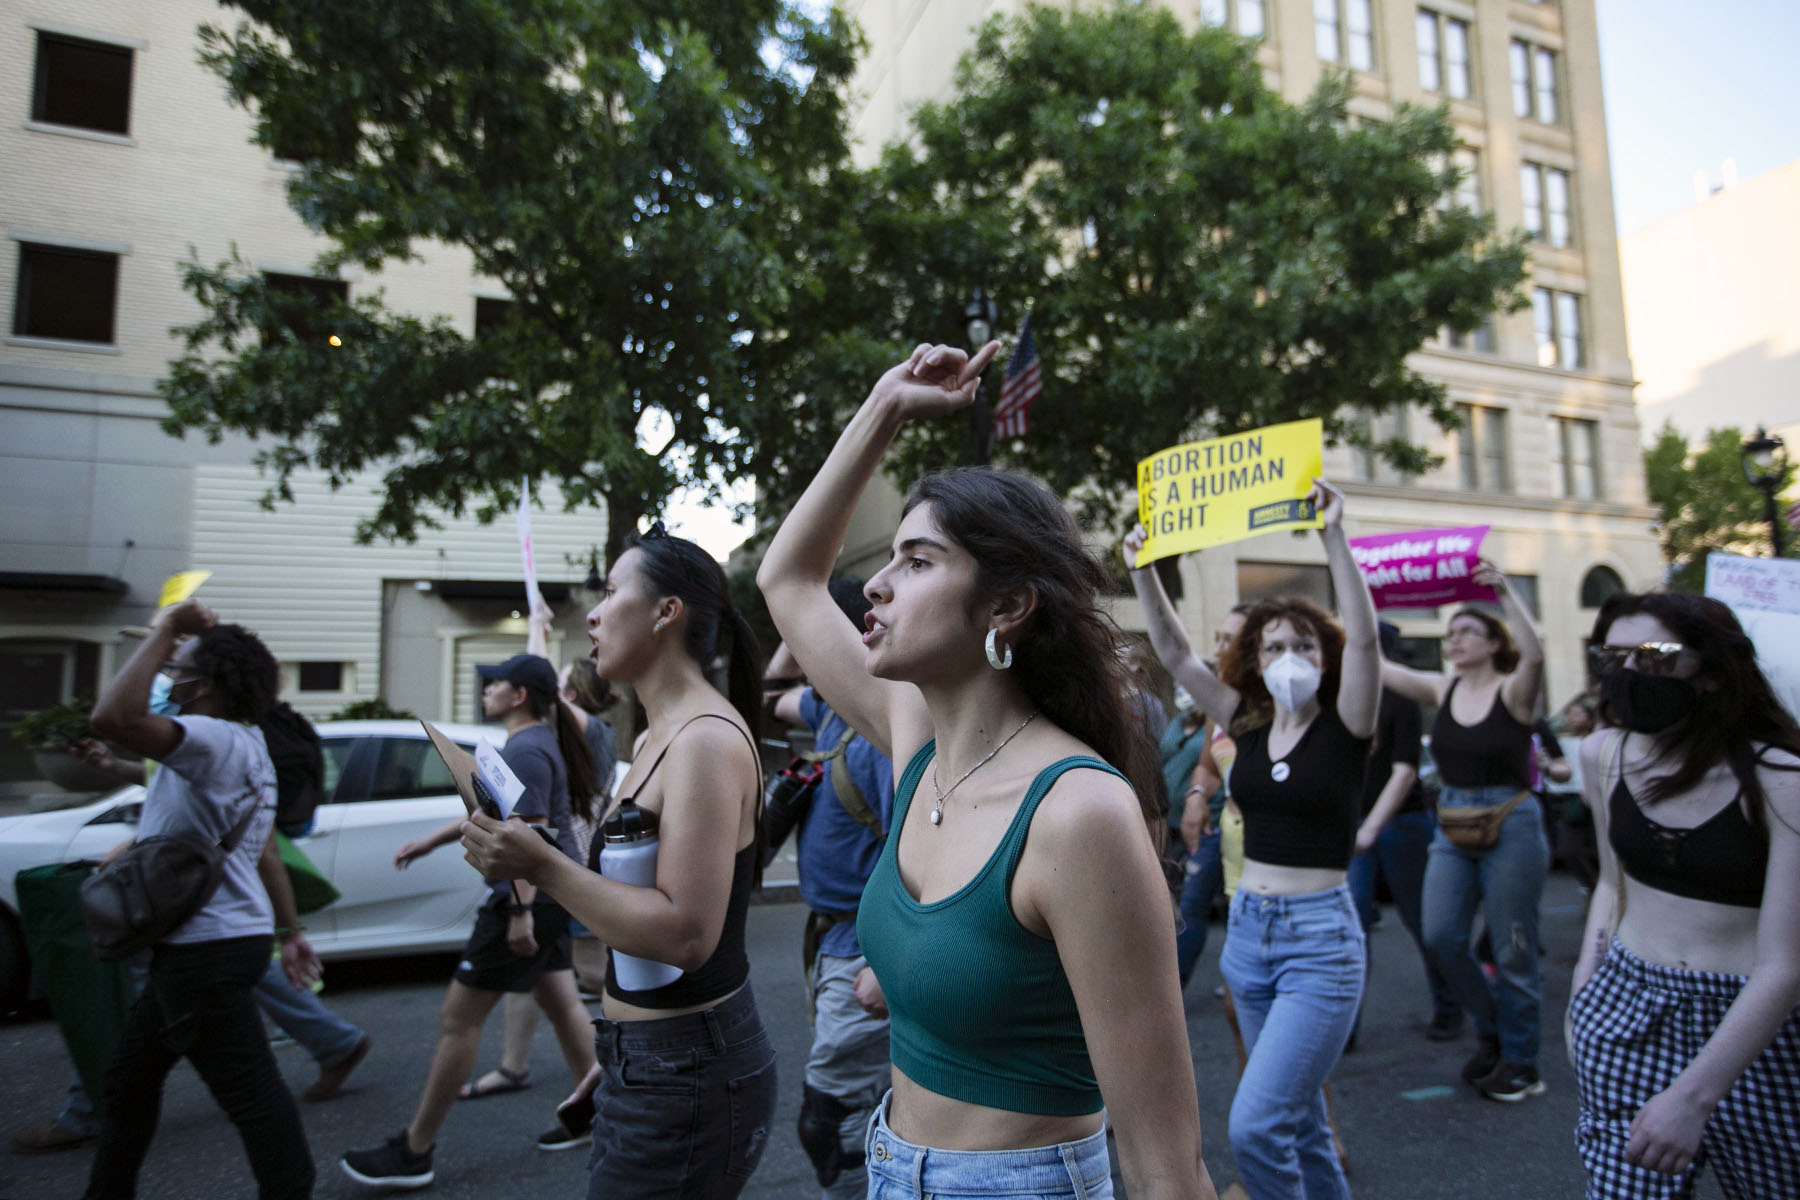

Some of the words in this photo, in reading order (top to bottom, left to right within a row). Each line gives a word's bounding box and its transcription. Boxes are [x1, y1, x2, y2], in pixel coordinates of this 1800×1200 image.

[1142, 435, 1263, 486] ABORTION
[1142, 487, 1158, 516] IS
[1167, 481, 1181, 504] A
[1191, 458, 1284, 501] HUMAN
[1436, 535, 1473, 555] We
[1401, 560, 1433, 582] for
[1436, 555, 1469, 579] All
